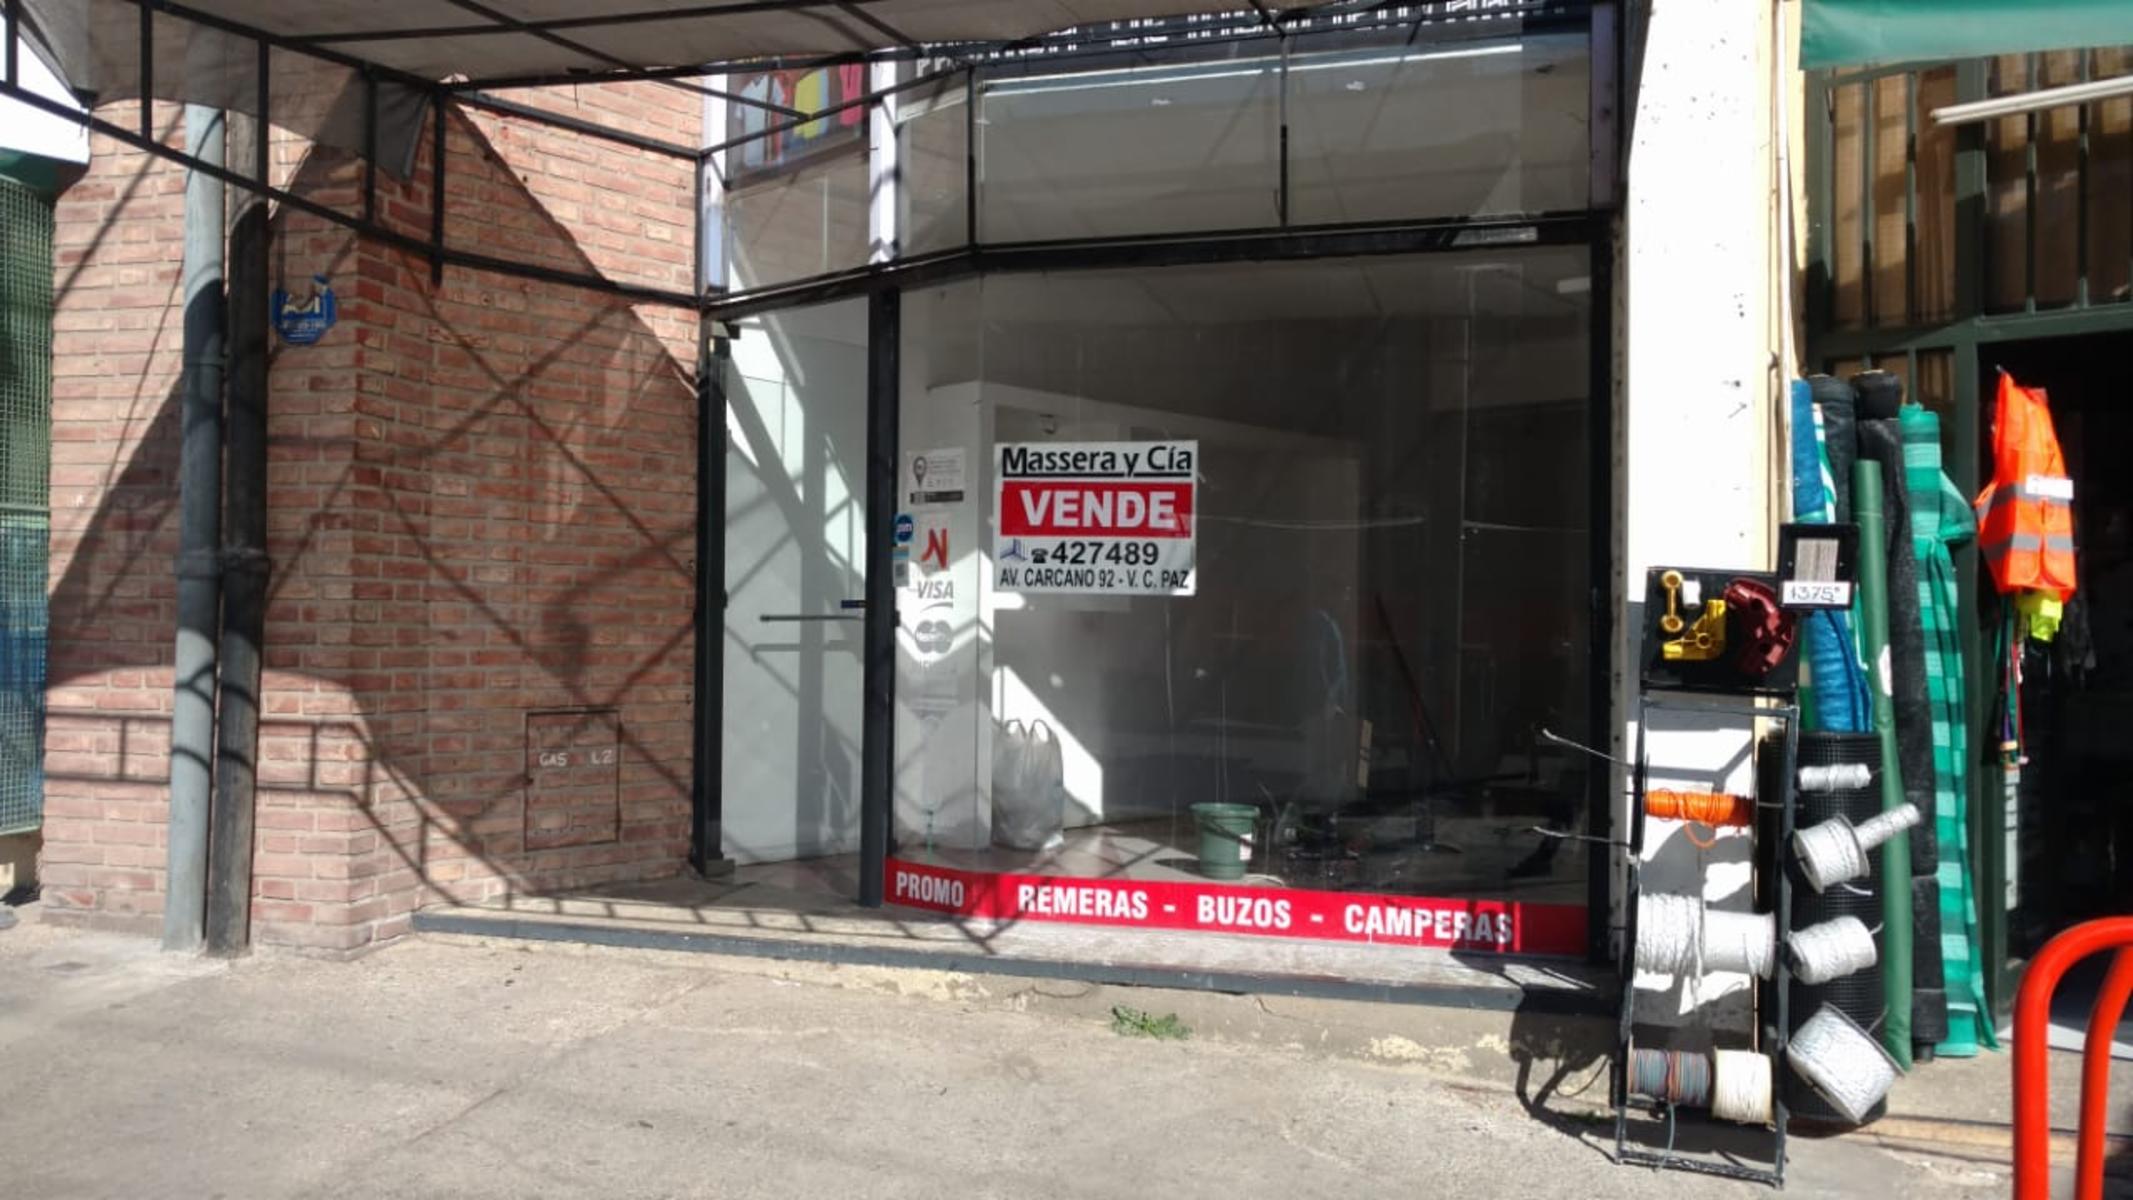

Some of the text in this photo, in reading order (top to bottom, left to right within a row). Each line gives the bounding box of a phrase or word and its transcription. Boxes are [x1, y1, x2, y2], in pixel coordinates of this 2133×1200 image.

[1002, 446, 1192, 477] Massera y Cía
[1020, 490, 1176, 529] VENDE
[1050, 540, 1160, 565] 427489
[917, 580, 954, 599] VISA
[1000, 568, 1019, 588] AV.
[1024, 568, 1095, 588] CARCANO
[1099, 569, 1115, 588] 92
[1127, 570, 1138, 589] V.
[1142, 570, 1157, 589] C.
[1161, 570, 1189, 590] PAZ
[539, 752, 568, 767] GAS
[895, 870, 964, 907] PROMO
[1018, 884, 1148, 919] REMERAS
[1197, 895, 1291, 928] BUZOS
[1345, 904, 1513, 944] CAMPERAS
